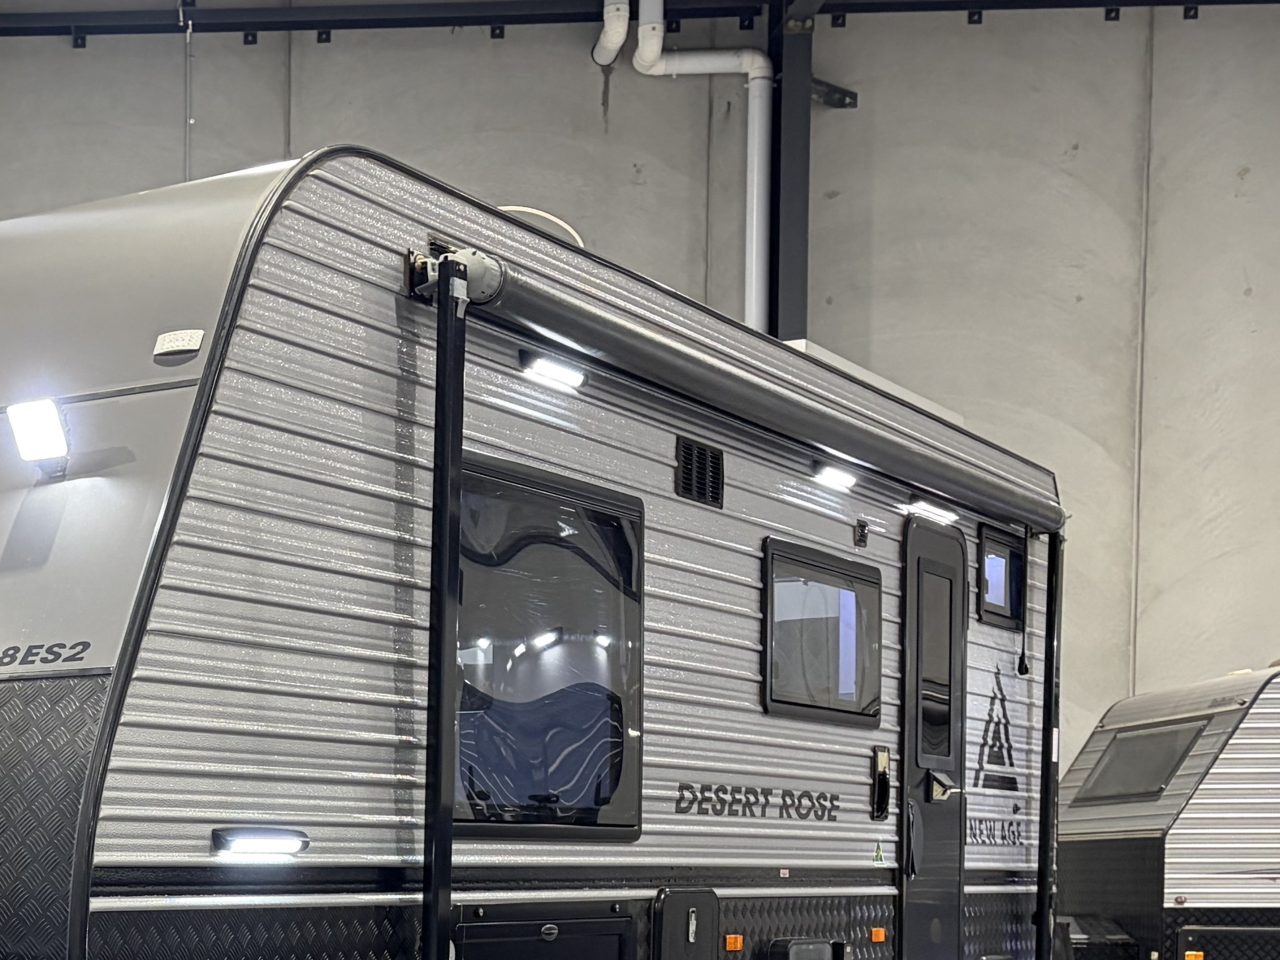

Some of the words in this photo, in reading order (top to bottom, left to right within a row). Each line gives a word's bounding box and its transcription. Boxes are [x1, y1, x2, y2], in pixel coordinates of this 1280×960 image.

[675, 782, 774, 818] DESERT
[778, 788, 840, 822] ROSE
[969, 819, 997, 845] NEW
[1001, 820, 1024, 846] AGE
